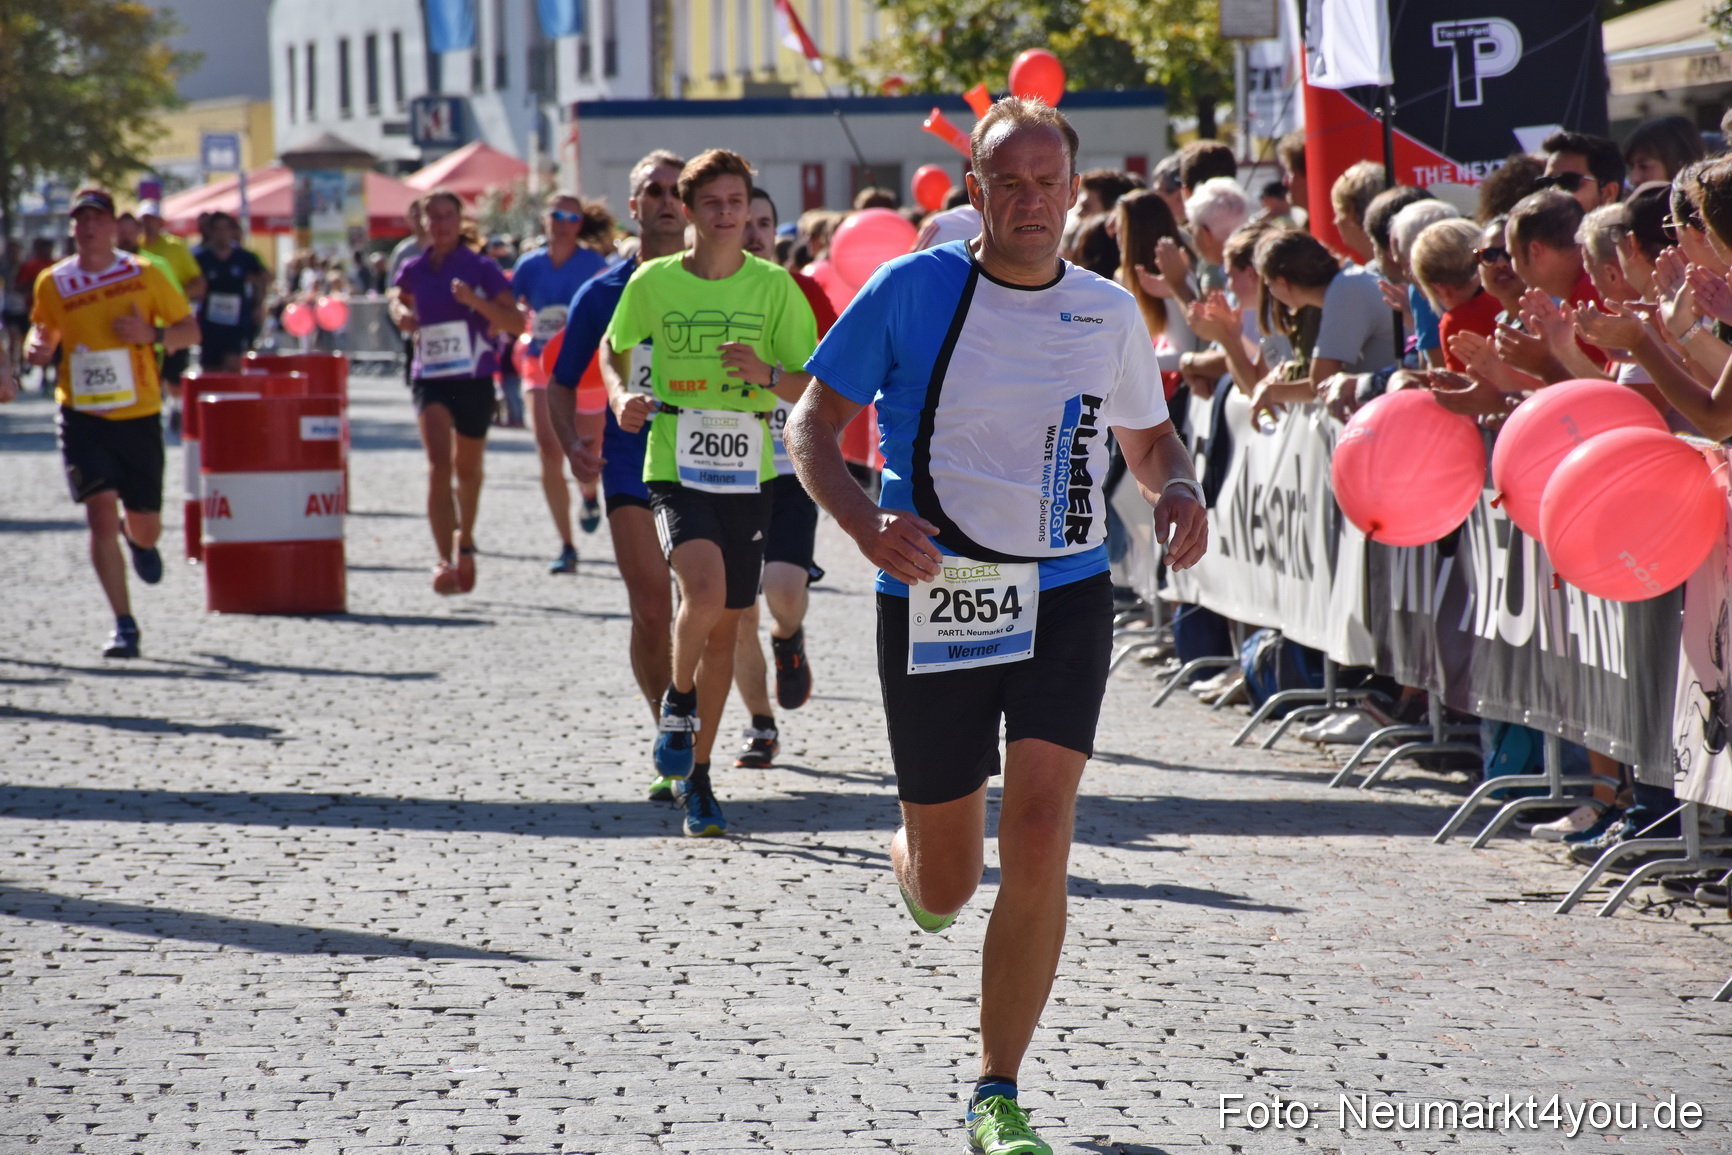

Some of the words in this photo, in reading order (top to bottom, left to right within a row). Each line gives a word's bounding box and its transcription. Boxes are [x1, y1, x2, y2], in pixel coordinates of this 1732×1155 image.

[1413, 165, 1452, 185] THE
[83, 368, 117, 386] 255
[689, 431, 748, 458] 2606
[1043, 424, 1057, 461] WASTE
[699, 471, 736, 484] Hannes
[1041, 463, 1052, 499] WATER
[1051, 425, 1074, 542] TECHNOLOGY
[1065, 393, 1104, 547] HUBER
[1038, 499, 1050, 543] Solutions
[943, 563, 1001, 580] BOCK
[929, 585, 1023, 624] 2654
[937, 629, 965, 637] PARTL
[966, 627, 1004, 637] Neumarkt
[947, 643, 1001, 659] Werner
